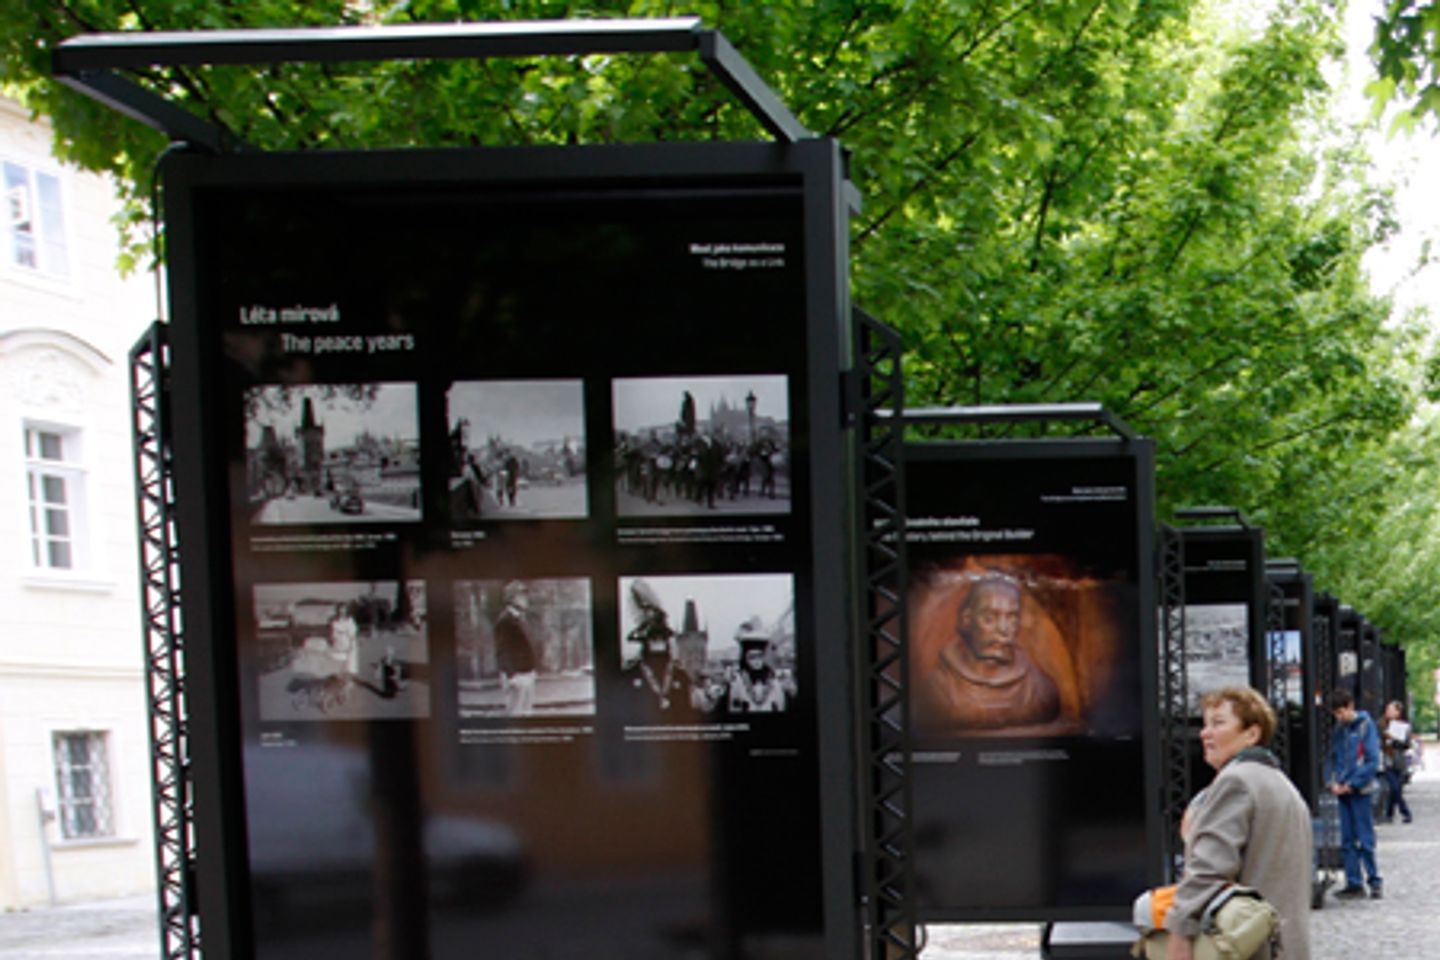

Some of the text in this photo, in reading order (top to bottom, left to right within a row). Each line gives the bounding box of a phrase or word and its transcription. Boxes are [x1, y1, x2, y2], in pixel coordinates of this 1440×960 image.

[719, 257, 747, 270] Bridge
[239, 302, 340, 325] Léta mírová
[281, 333, 415, 355] The peace years
